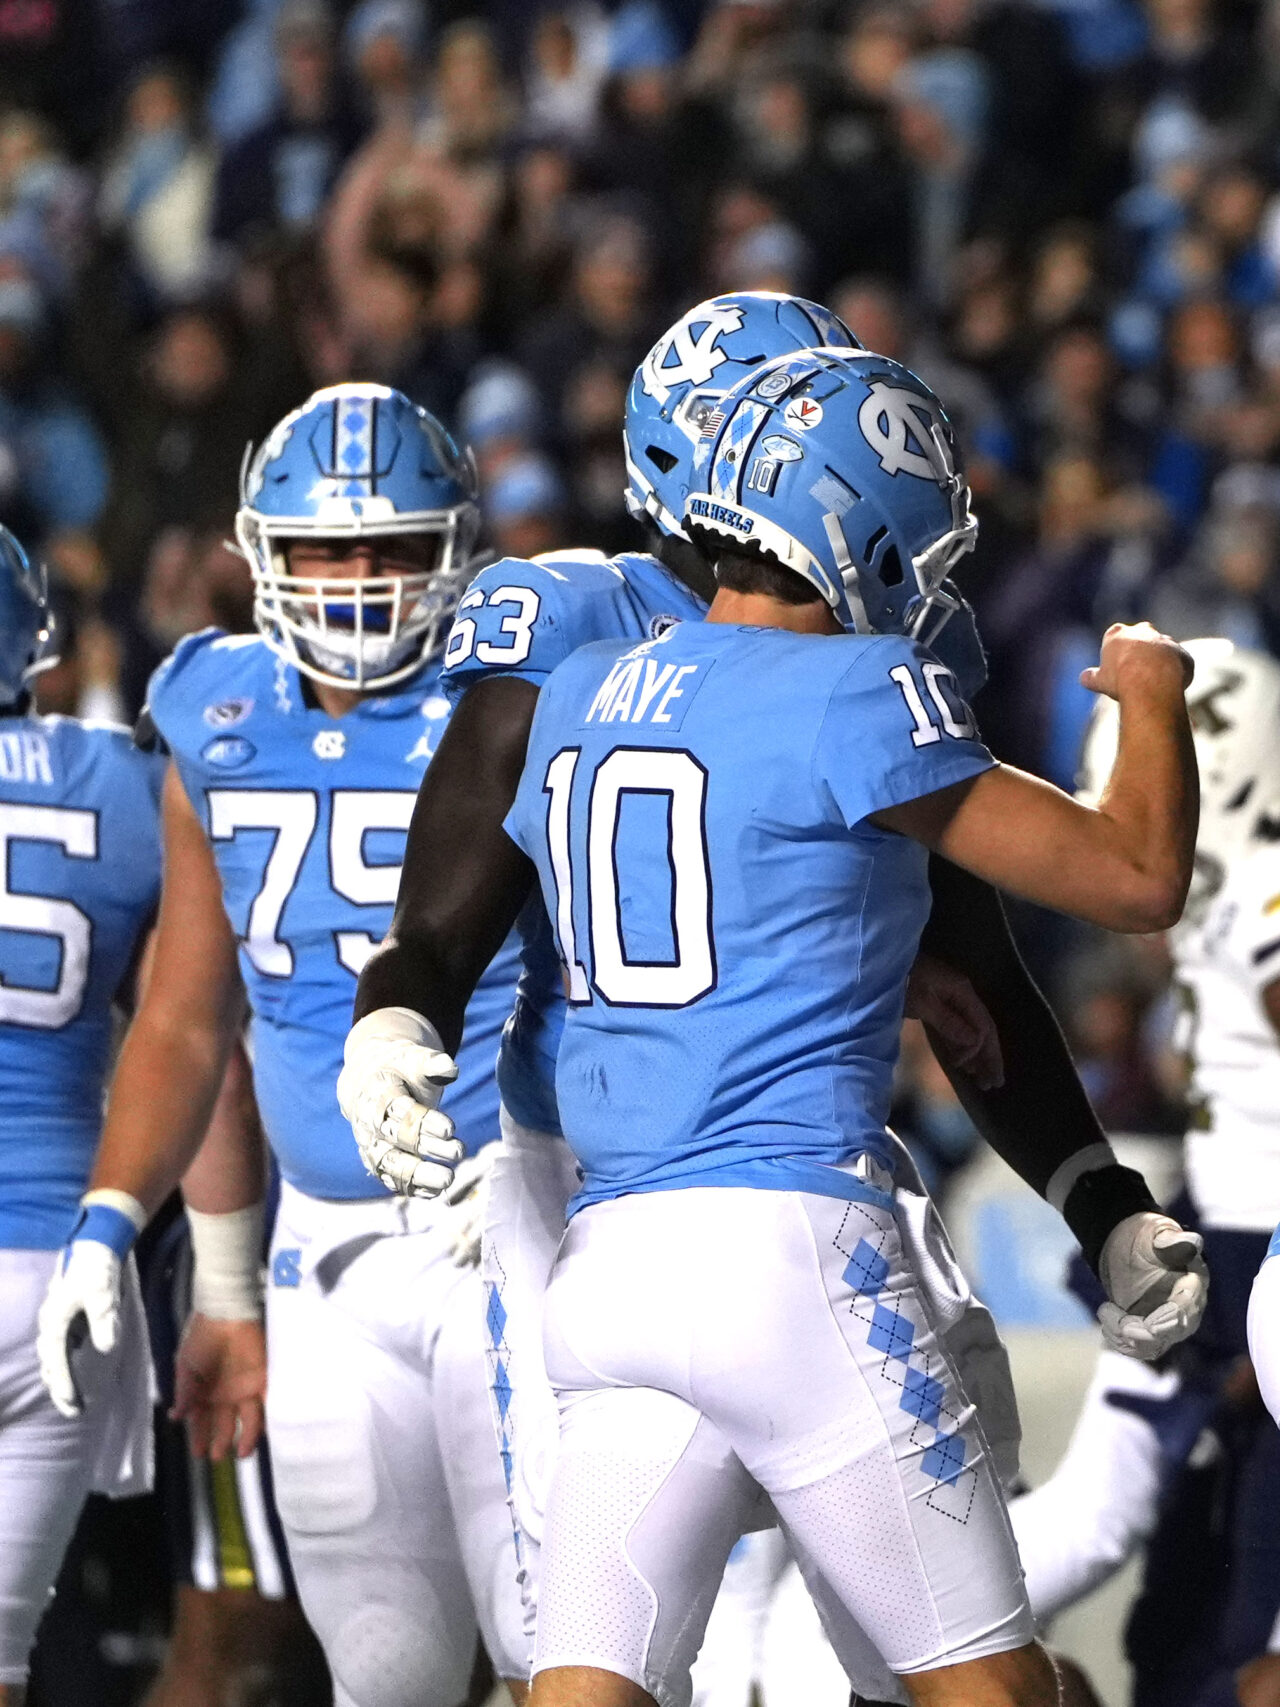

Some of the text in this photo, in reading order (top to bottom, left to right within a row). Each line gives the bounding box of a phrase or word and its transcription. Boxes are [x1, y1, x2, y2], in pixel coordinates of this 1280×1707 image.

[710, 503, 755, 534] HEELS
[747, 458, 776, 494] 10
[444, 585, 541, 670] 63
[584, 658, 698, 723] MAYE
[888, 663, 976, 748] 10
[203, 787, 420, 979] 75
[541, 744, 718, 1010] 10
